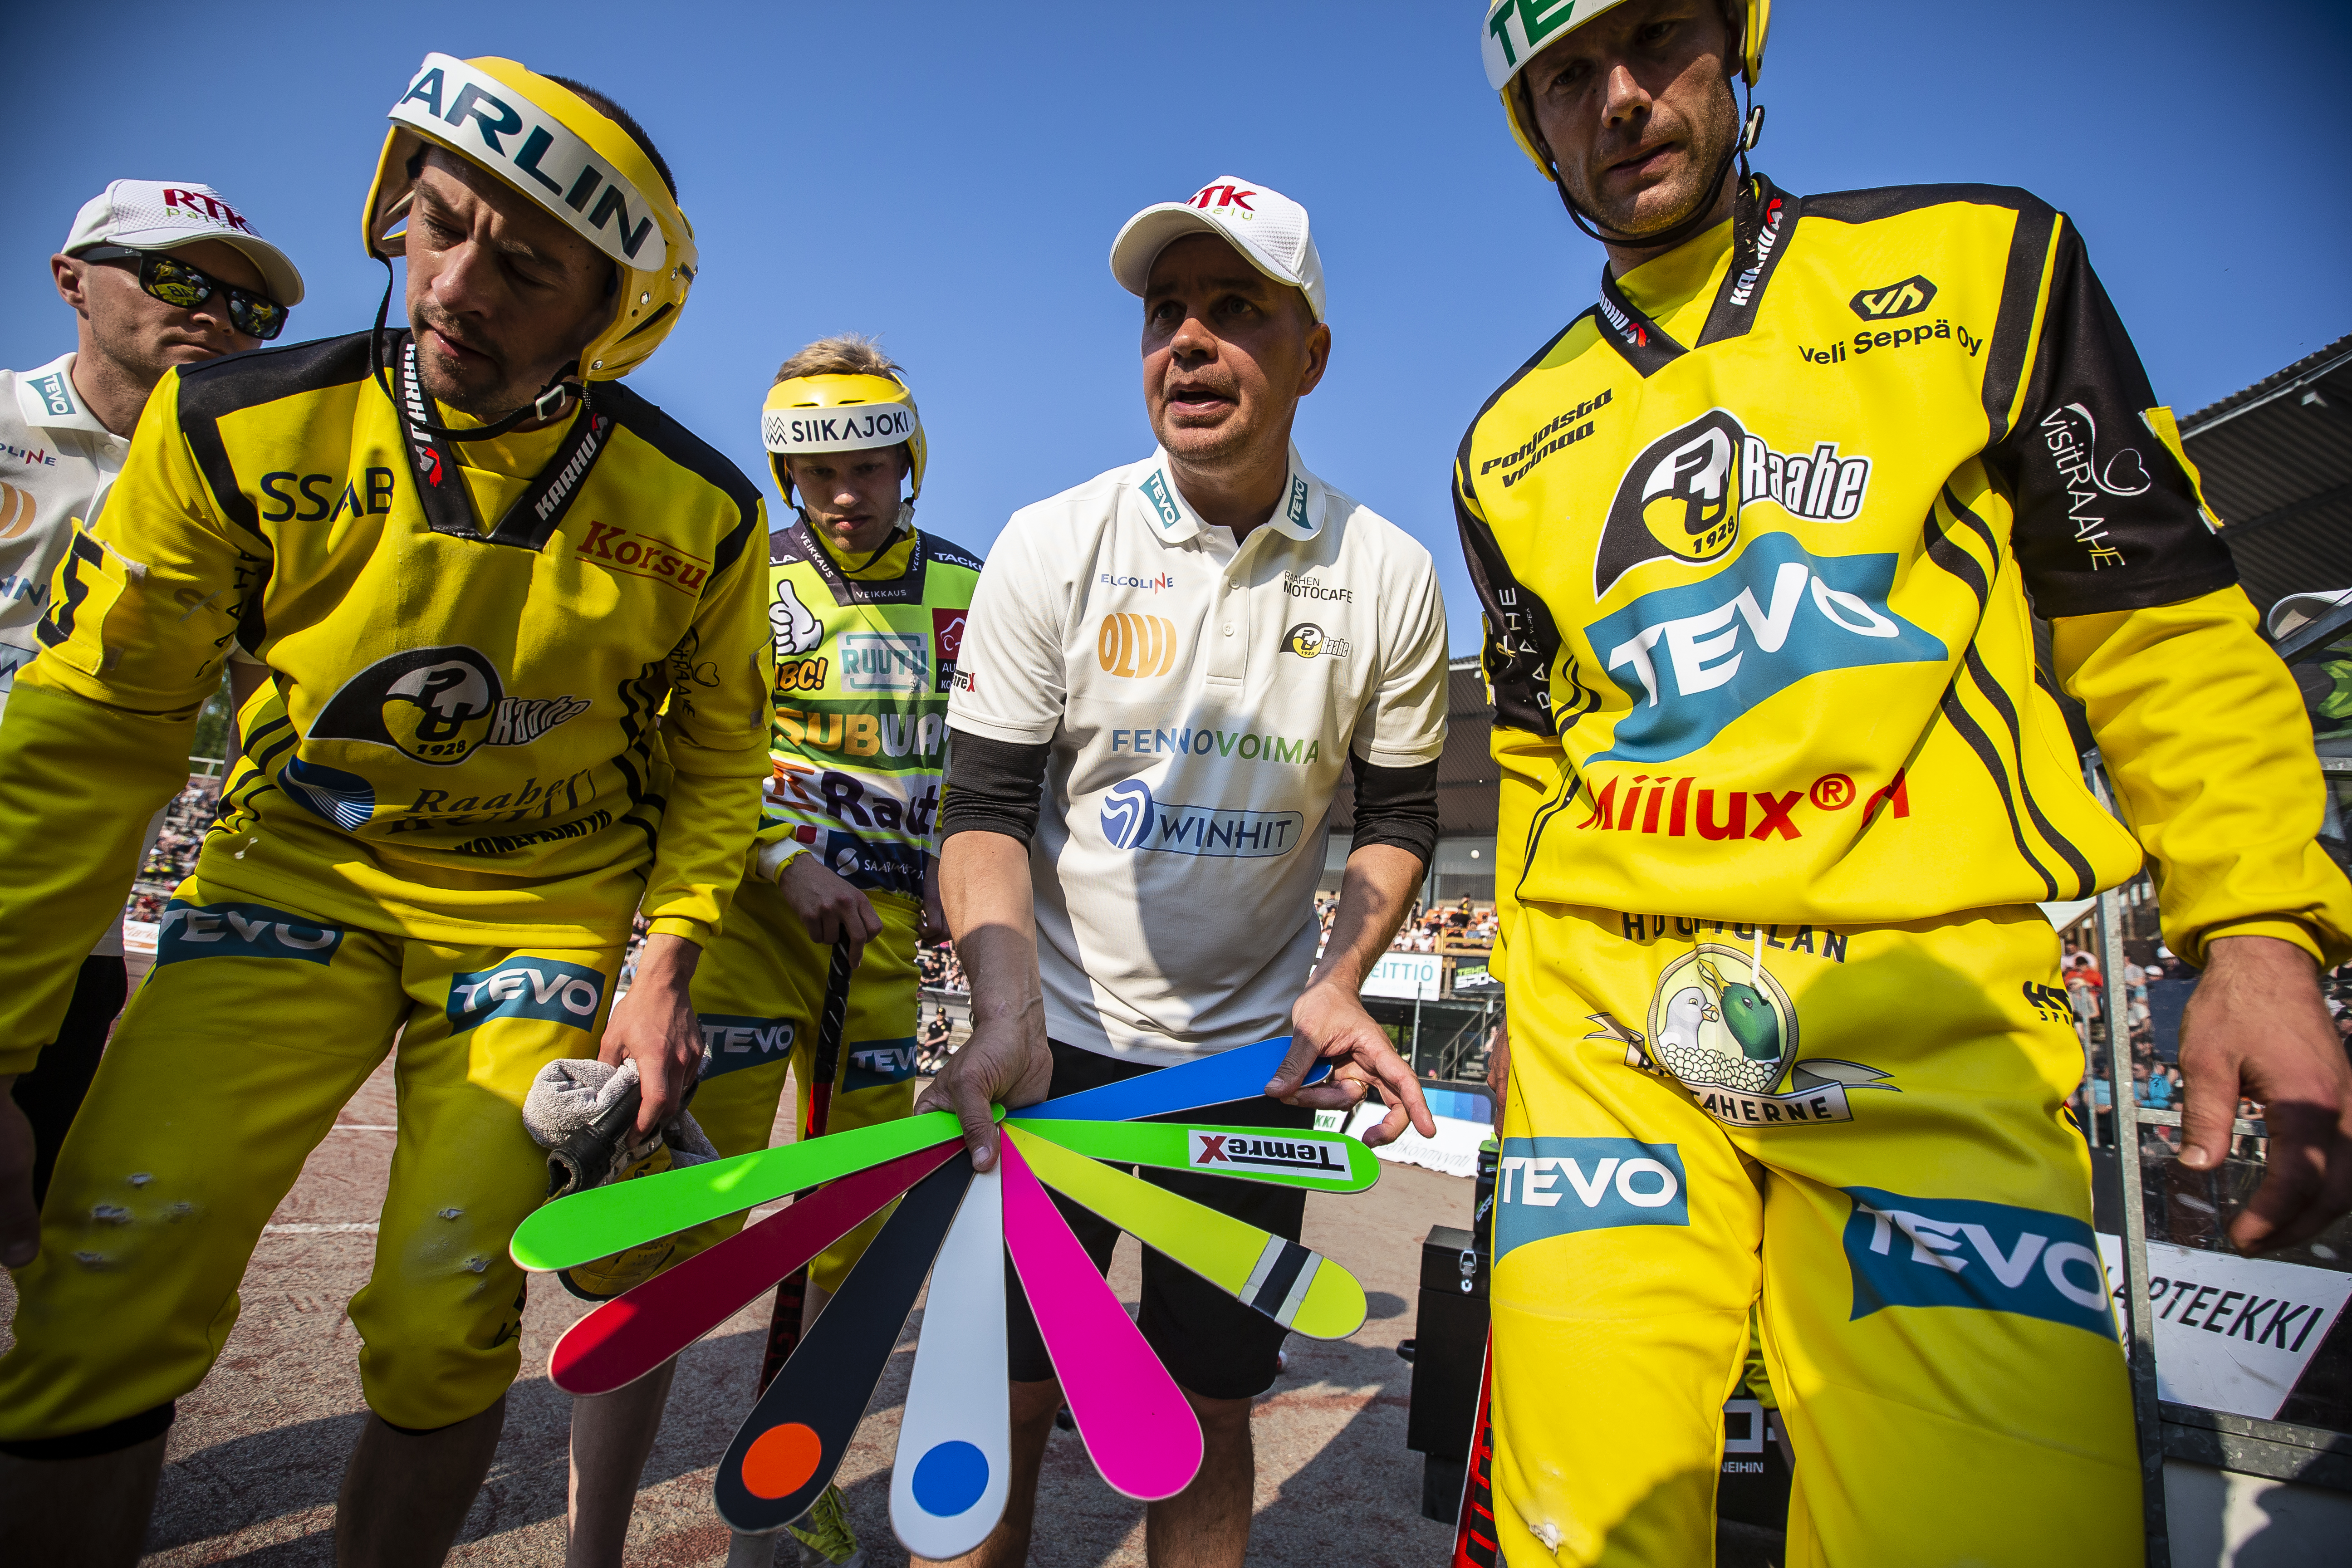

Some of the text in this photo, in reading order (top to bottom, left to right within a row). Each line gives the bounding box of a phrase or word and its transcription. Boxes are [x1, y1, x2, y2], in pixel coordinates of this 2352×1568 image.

[162, 189, 252, 235] RTK
[1185, 185, 1257, 209] TK
[1205, 207, 1253, 221] elu
[1599, 287, 1630, 330] ARHU
[1798, 319, 1983, 364] Veli Seppä Oy
[44, 374, 69, 414] TEVO
[791, 411, 909, 442] SIIKAJOKI
[1480, 387, 1614, 476] Pohjoista
[1501, 420, 1596, 488] voimaa
[260, 467, 394, 522] SSAB
[535, 432, 597, 521] KARHU
[1742, 434, 1867, 519] Raahe
[1150, 473, 1176, 524] TEVO
[1291, 479, 1304, 519] TEVO
[576, 520, 707, 590] Korsu
[800, 532, 834, 578] VEIKKAUS
[1693, 515, 1735, 554] 1928
[856, 589, 906, 599] VEIKKAUS
[1101, 572, 1173, 594] ELCOLINE
[1284, 581, 1352, 604] MOTOCAFE
[1285, 571, 1320, 586] RAAHEN
[1320, 636, 1350, 657] Raahe
[1608, 561, 1900, 708] TEVO
[842, 648, 927, 676] RUUTU
[487, 695, 593, 745] Raahe
[417, 740, 467, 756] 1928
[1112, 728, 1319, 764] FENNOVOIMA
[1160, 814, 1293, 850] WINHIT
[159, 908, 335, 951] TEVO
[1457, 965, 1486, 976] TEHO
[454, 968, 598, 1015] TEVO
[701, 1024, 794, 1054] TEVO
[1500, 1156, 1678, 1207] TEVO
[1856, 1203, 2109, 1313] TEVO
